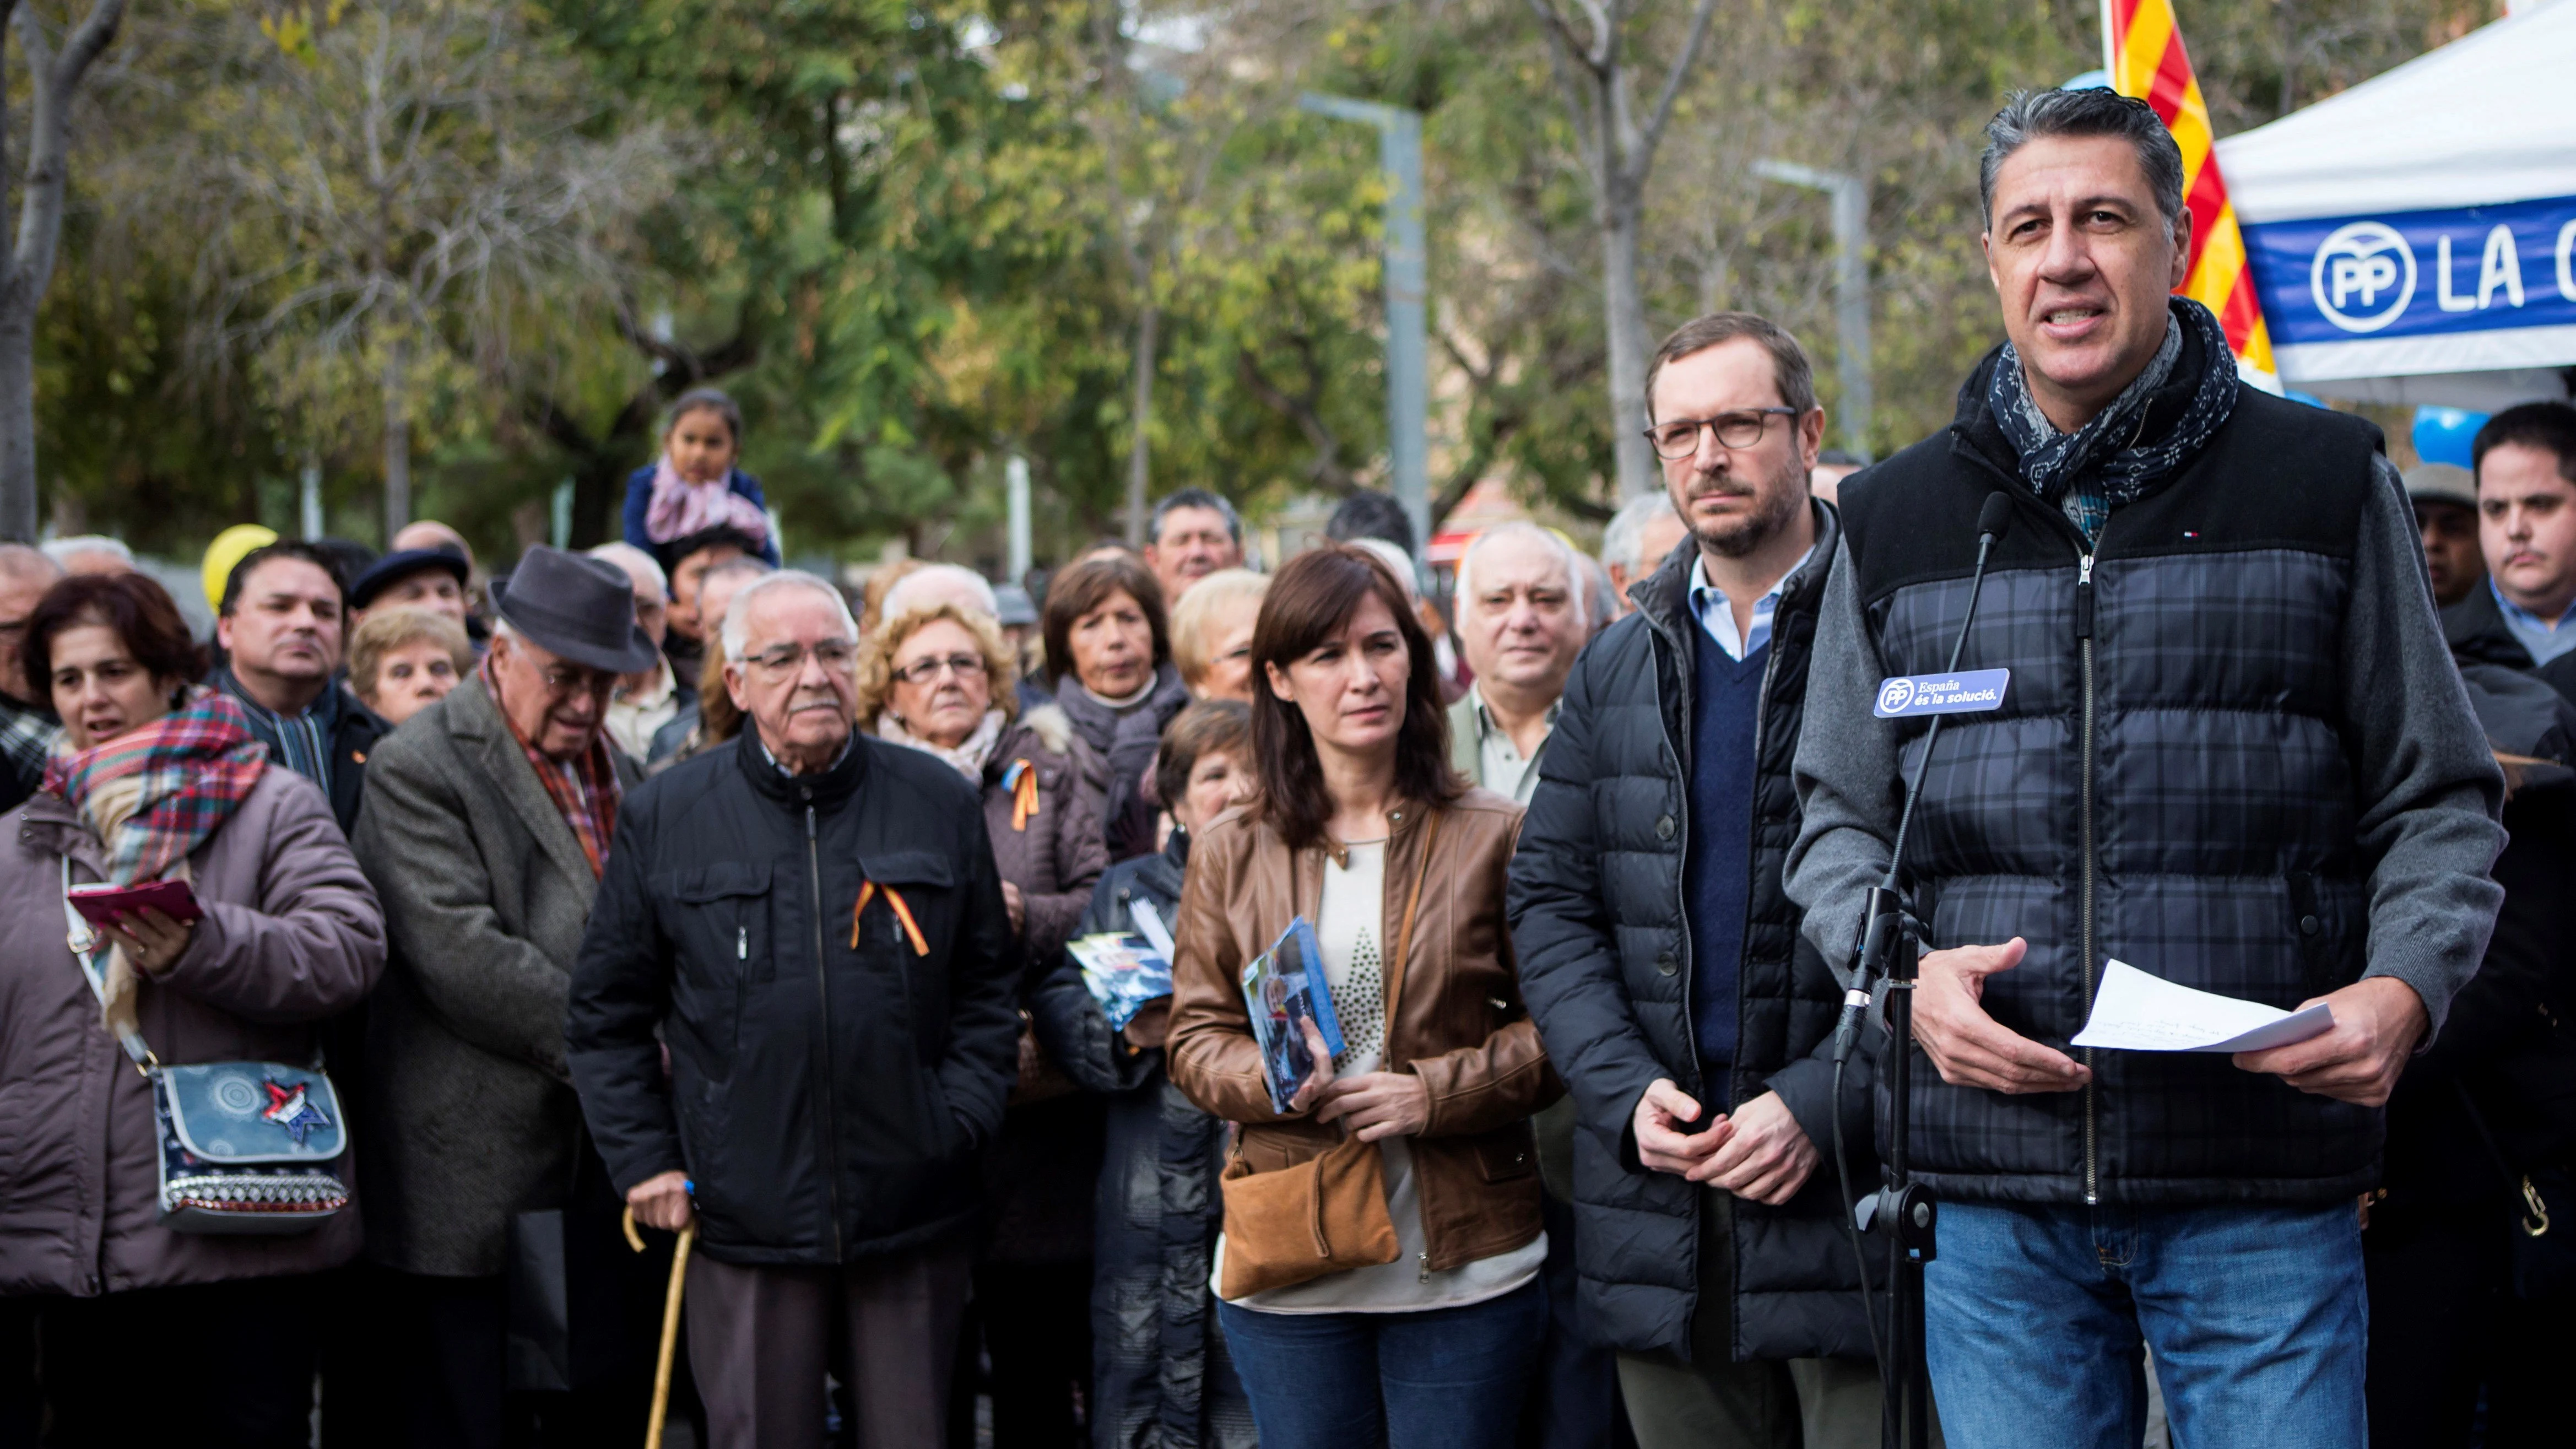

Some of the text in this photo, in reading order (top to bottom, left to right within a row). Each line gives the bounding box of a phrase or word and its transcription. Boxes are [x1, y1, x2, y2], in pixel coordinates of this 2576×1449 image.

[2437, 224, 2525, 312] LA
[2333, 255, 2397, 309] PP
[1918, 680, 1960, 695] España
[1885, 690, 1908, 706] PP
[1914, 689, 1997, 706] és la solució.
